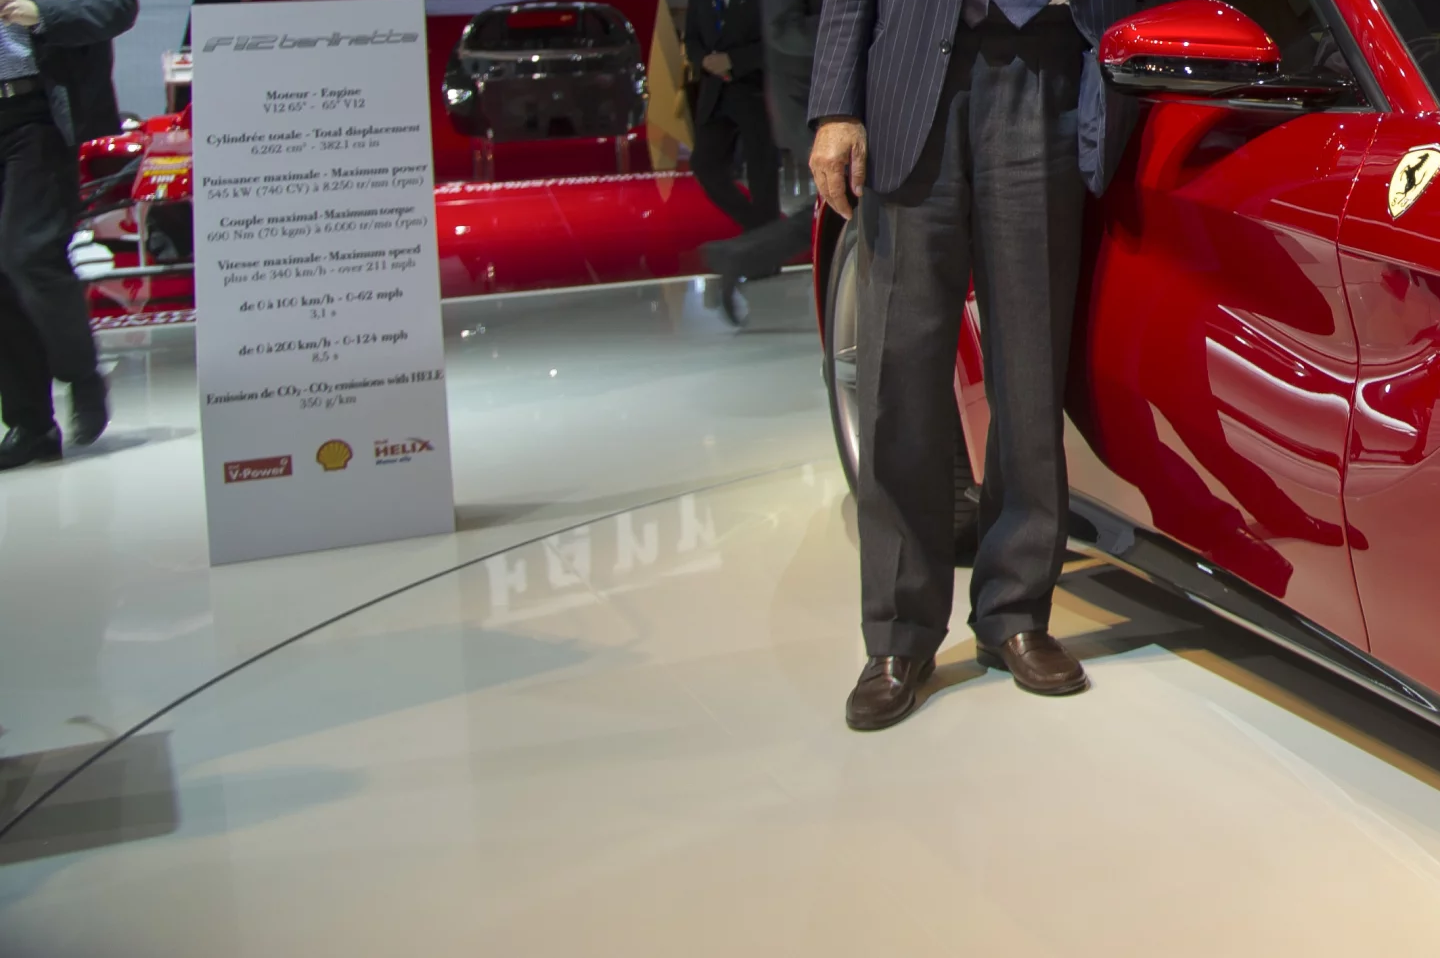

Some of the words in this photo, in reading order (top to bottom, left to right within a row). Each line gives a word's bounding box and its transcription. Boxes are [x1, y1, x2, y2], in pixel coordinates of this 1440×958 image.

[263, 102, 286, 114] V12
[343, 98, 366, 109] V12
[266, 90, 309, 101] Moteur
[321, 87, 362, 100] Engine
[206, 132, 265, 148] Cylindrée
[268, 129, 302, 141] totale
[312, 127, 342, 139] Total
[345, 124, 420, 139] displacement
[203, 175, 261, 187] Puissance
[263, 169, 320, 183] maximale
[331, 166, 389, 179] Maximum
[392, 163, 429, 177] power
[232, 186, 252, 199] kW
[220, 214, 264, 230] Couple
[267, 210, 318, 225] maximal
[324, 206, 378, 220] Maximum
[380, 206, 415, 218] torque
[218, 259, 260, 271] Vitesse
[263, 253, 321, 268] maximale
[329, 249, 386, 261] Maximum
[388, 244, 422, 259] speed
[224, 273, 248, 288] plus
[251, 270, 267, 282] de
[295, 264, 327, 278] km/h
[338, 263, 364, 274] over
[366, 260, 387, 272] 211
[391, 257, 416, 272] mph
[240, 301, 256, 312] de
[301, 292, 335, 307] km/h
[376, 287, 403, 302] mph
[239, 345, 255, 356] de
[298, 336, 331, 351] km/h
[381, 329, 408, 344] mph
[206, 390, 259, 405] Emission
[261, 388, 275, 399] de
[334, 377, 385, 391] emissions
[387, 373, 409, 386] with
[375, 441, 434, 457] HELIX
[229, 465, 286, 480] V-Power
